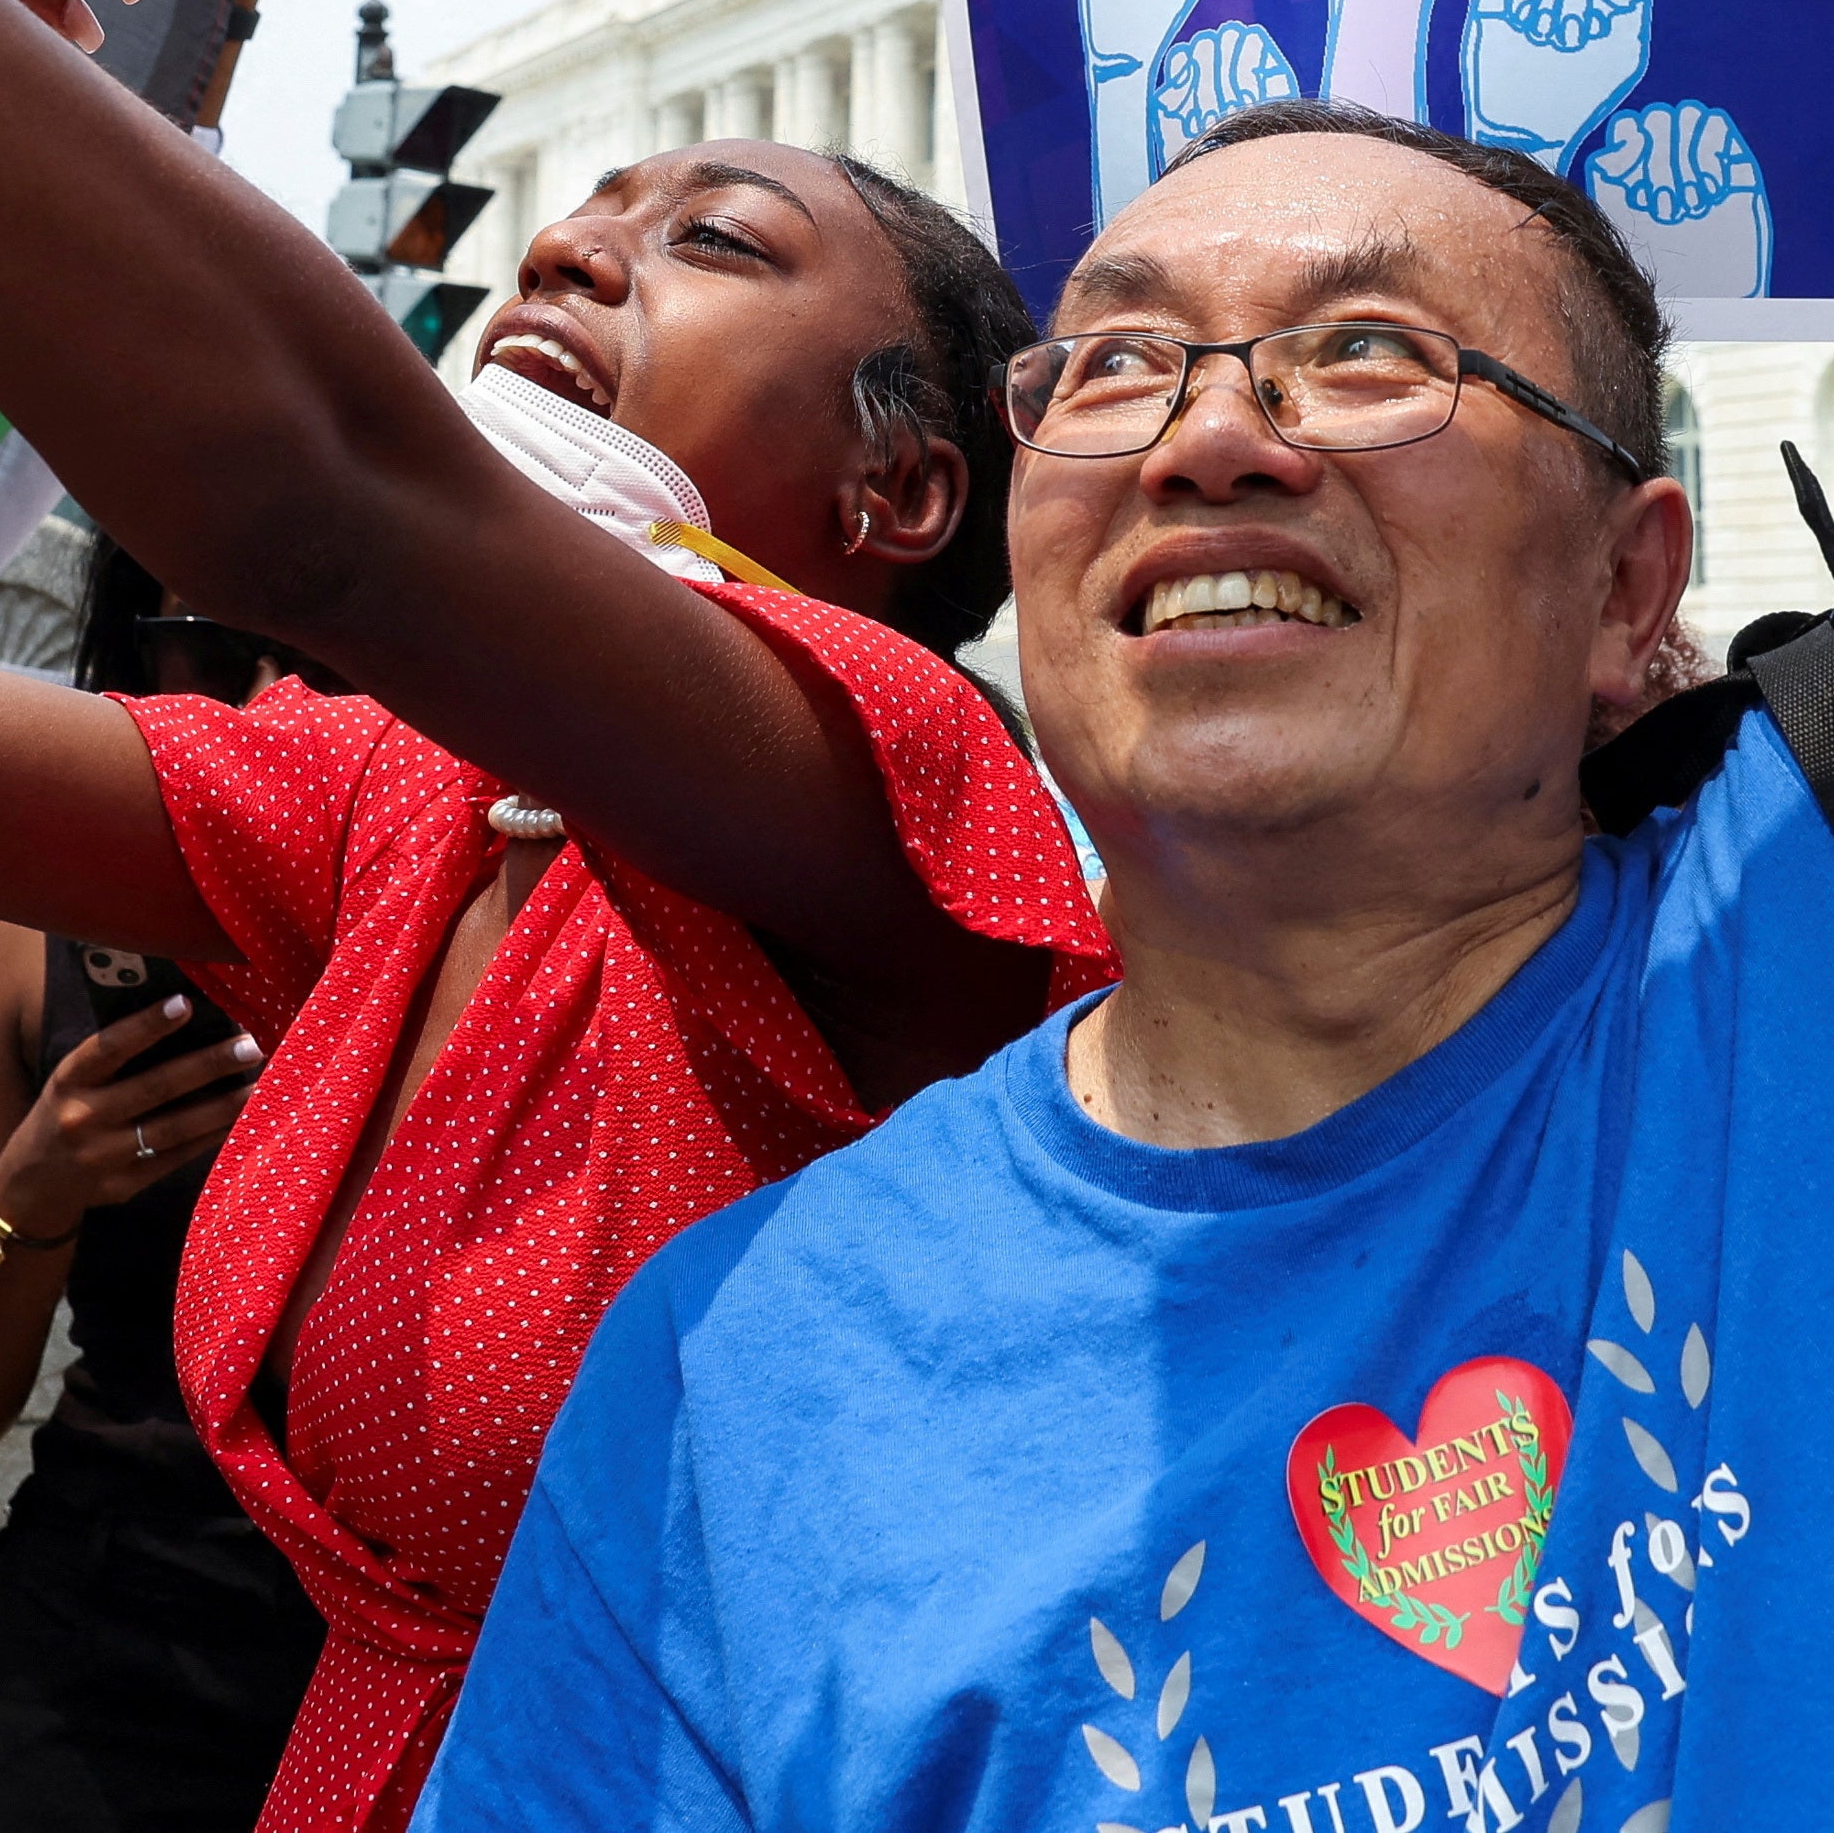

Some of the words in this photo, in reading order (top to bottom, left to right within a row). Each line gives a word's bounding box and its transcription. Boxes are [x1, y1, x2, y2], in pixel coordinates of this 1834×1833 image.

[1320, 1410, 1540, 1516] STUDENTS
[1376, 1503, 1426, 1560] for
[1431, 1470, 1515, 1523] FAIR
